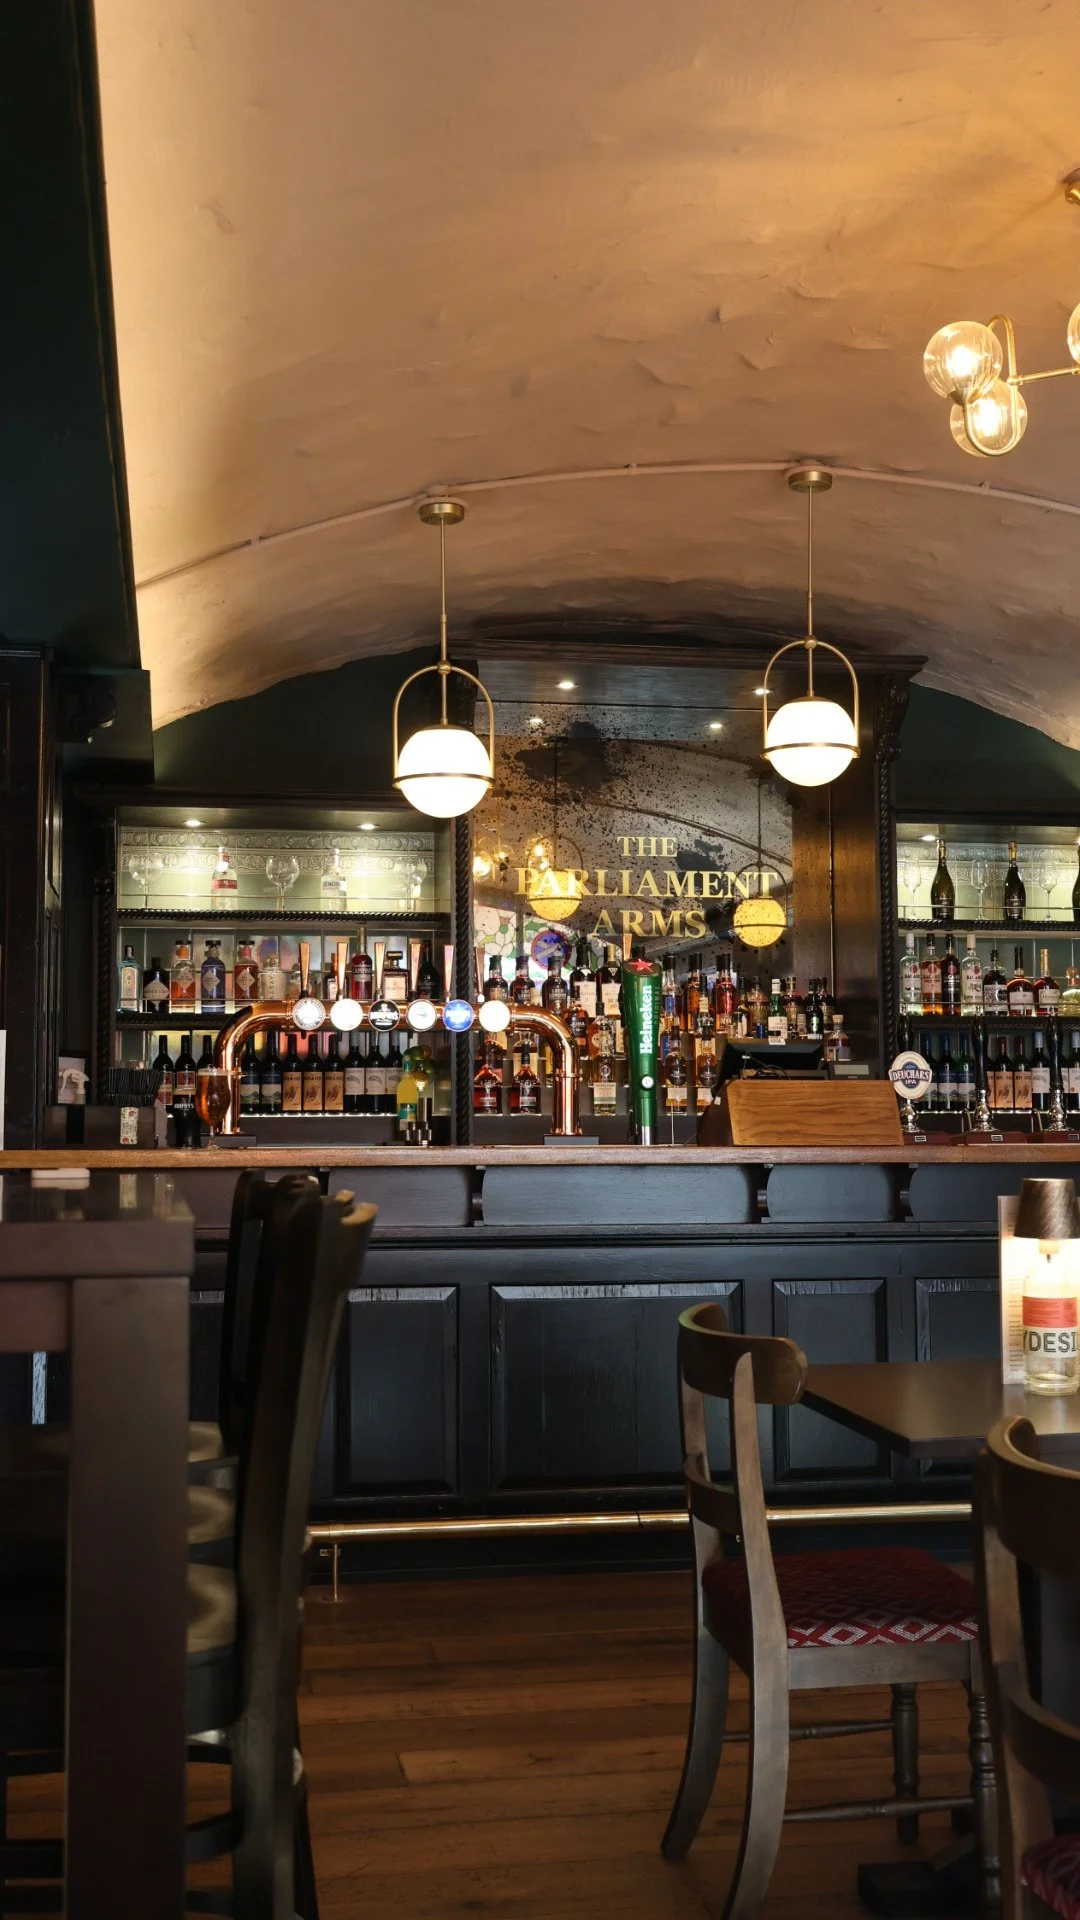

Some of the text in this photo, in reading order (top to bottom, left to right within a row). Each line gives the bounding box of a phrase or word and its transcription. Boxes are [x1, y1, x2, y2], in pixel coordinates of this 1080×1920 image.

[616, 836, 679, 858] THE
[514, 867, 778, 899] PARLIAMENT
[590, 909, 706, 938] ARMS
[639, 984, 653, 1054] Heineken
[891, 1069, 930, 1081] DEUCHARS
